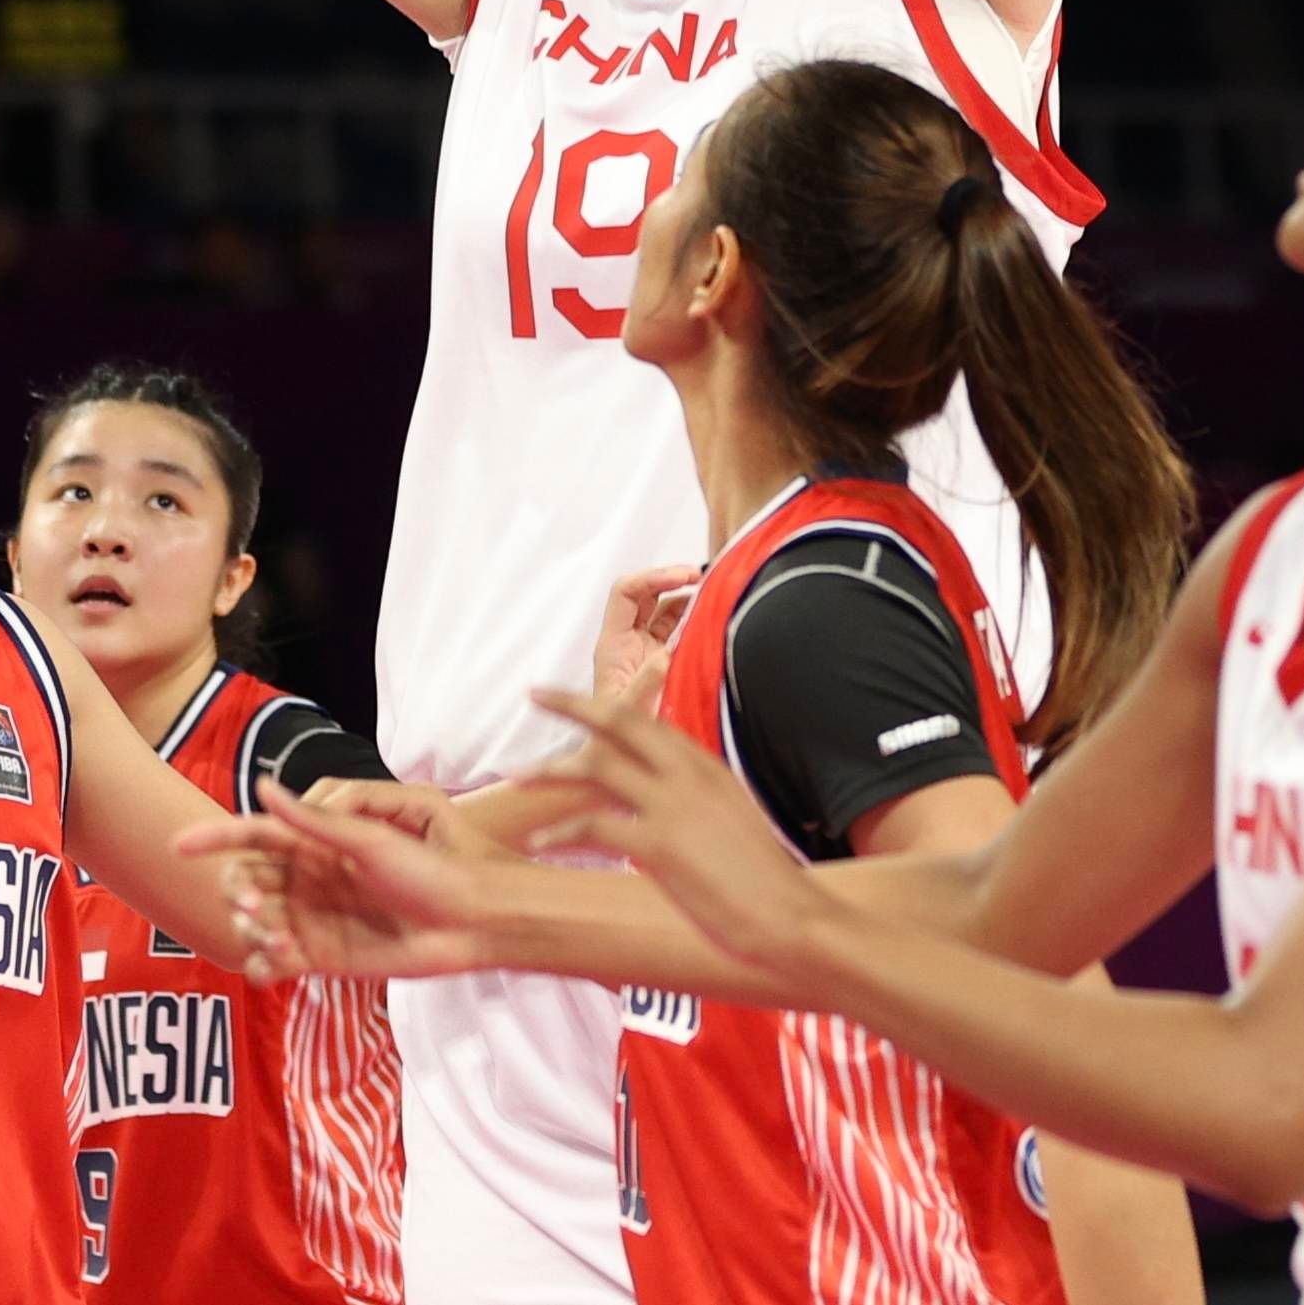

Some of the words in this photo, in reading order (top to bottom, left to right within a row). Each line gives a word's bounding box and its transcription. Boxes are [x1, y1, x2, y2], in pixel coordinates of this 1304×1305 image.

[505, 116, 678, 339] 19
[83, 992, 234, 1127] NESIA
[75, 1148, 118, 1284] 9
